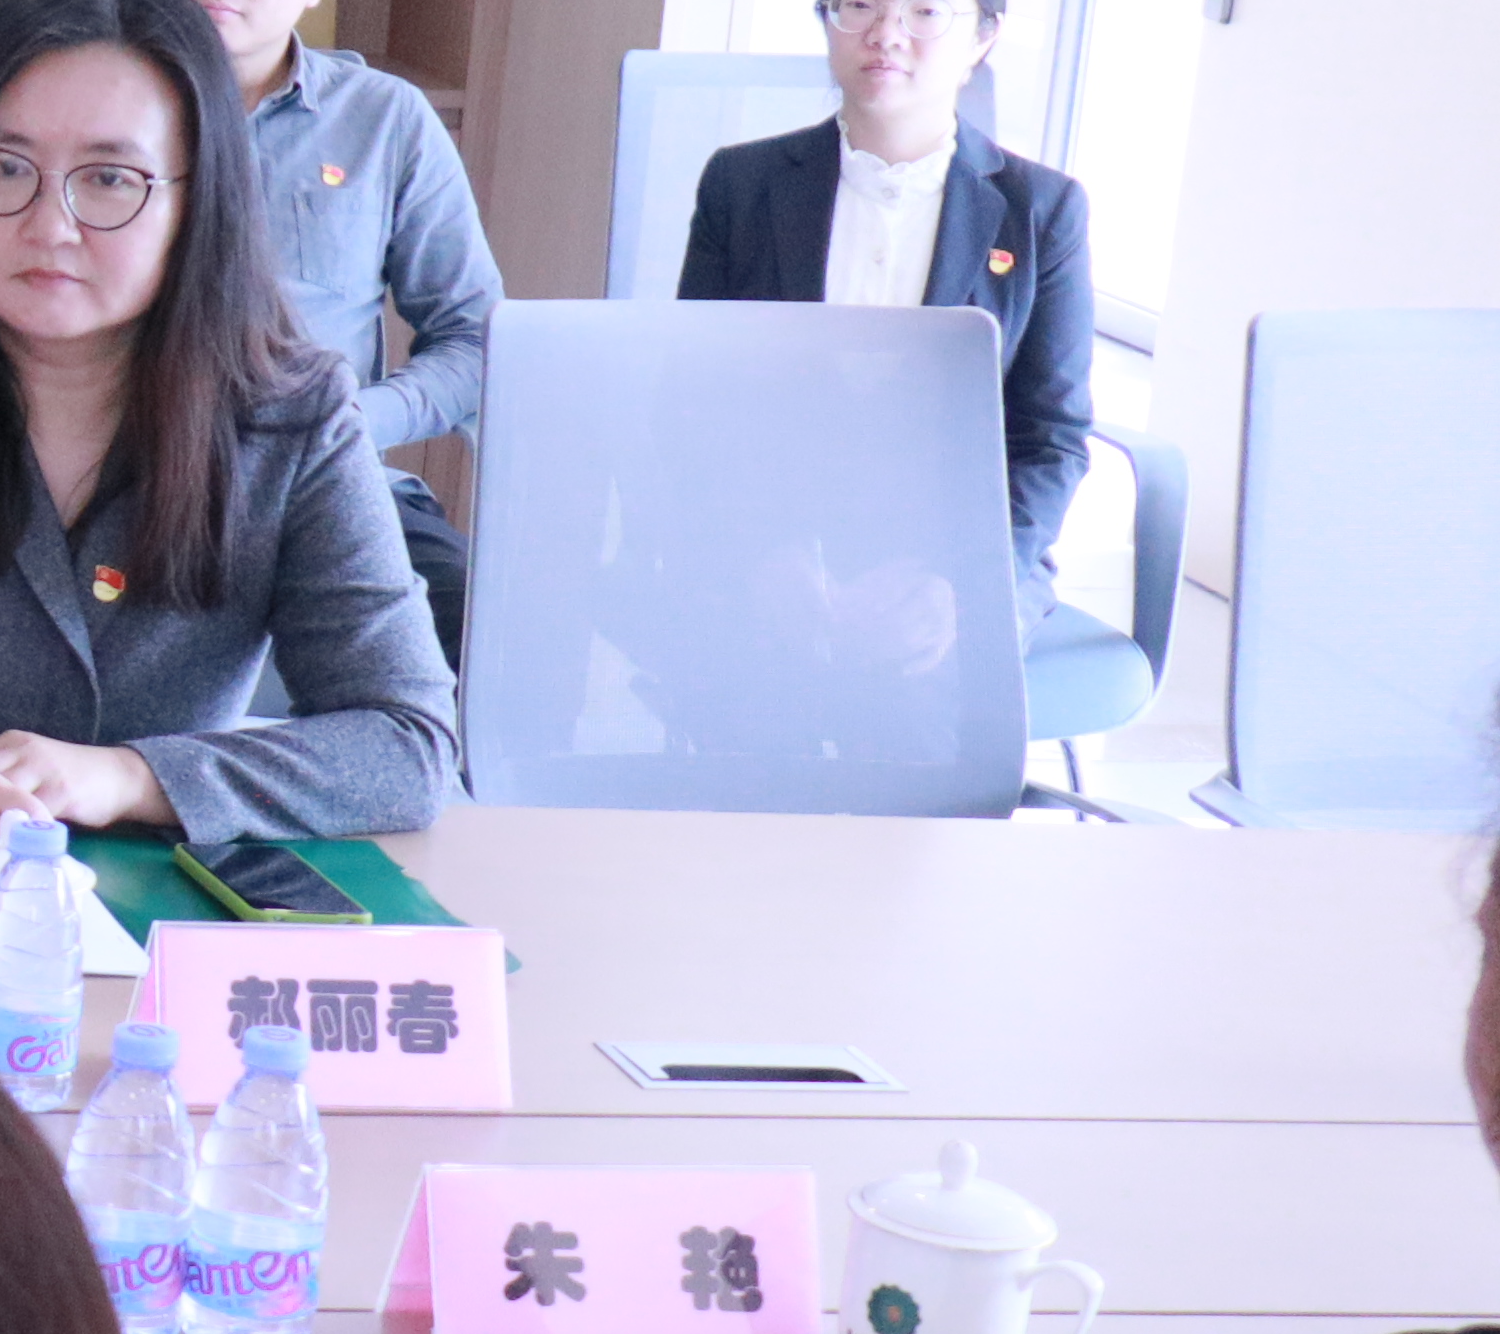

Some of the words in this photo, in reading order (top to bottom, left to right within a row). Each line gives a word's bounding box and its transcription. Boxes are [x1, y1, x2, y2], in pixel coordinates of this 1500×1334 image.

[227, 975, 460, 1055] 郝丽春
[503, 1221, 765, 1314] 朱艳
